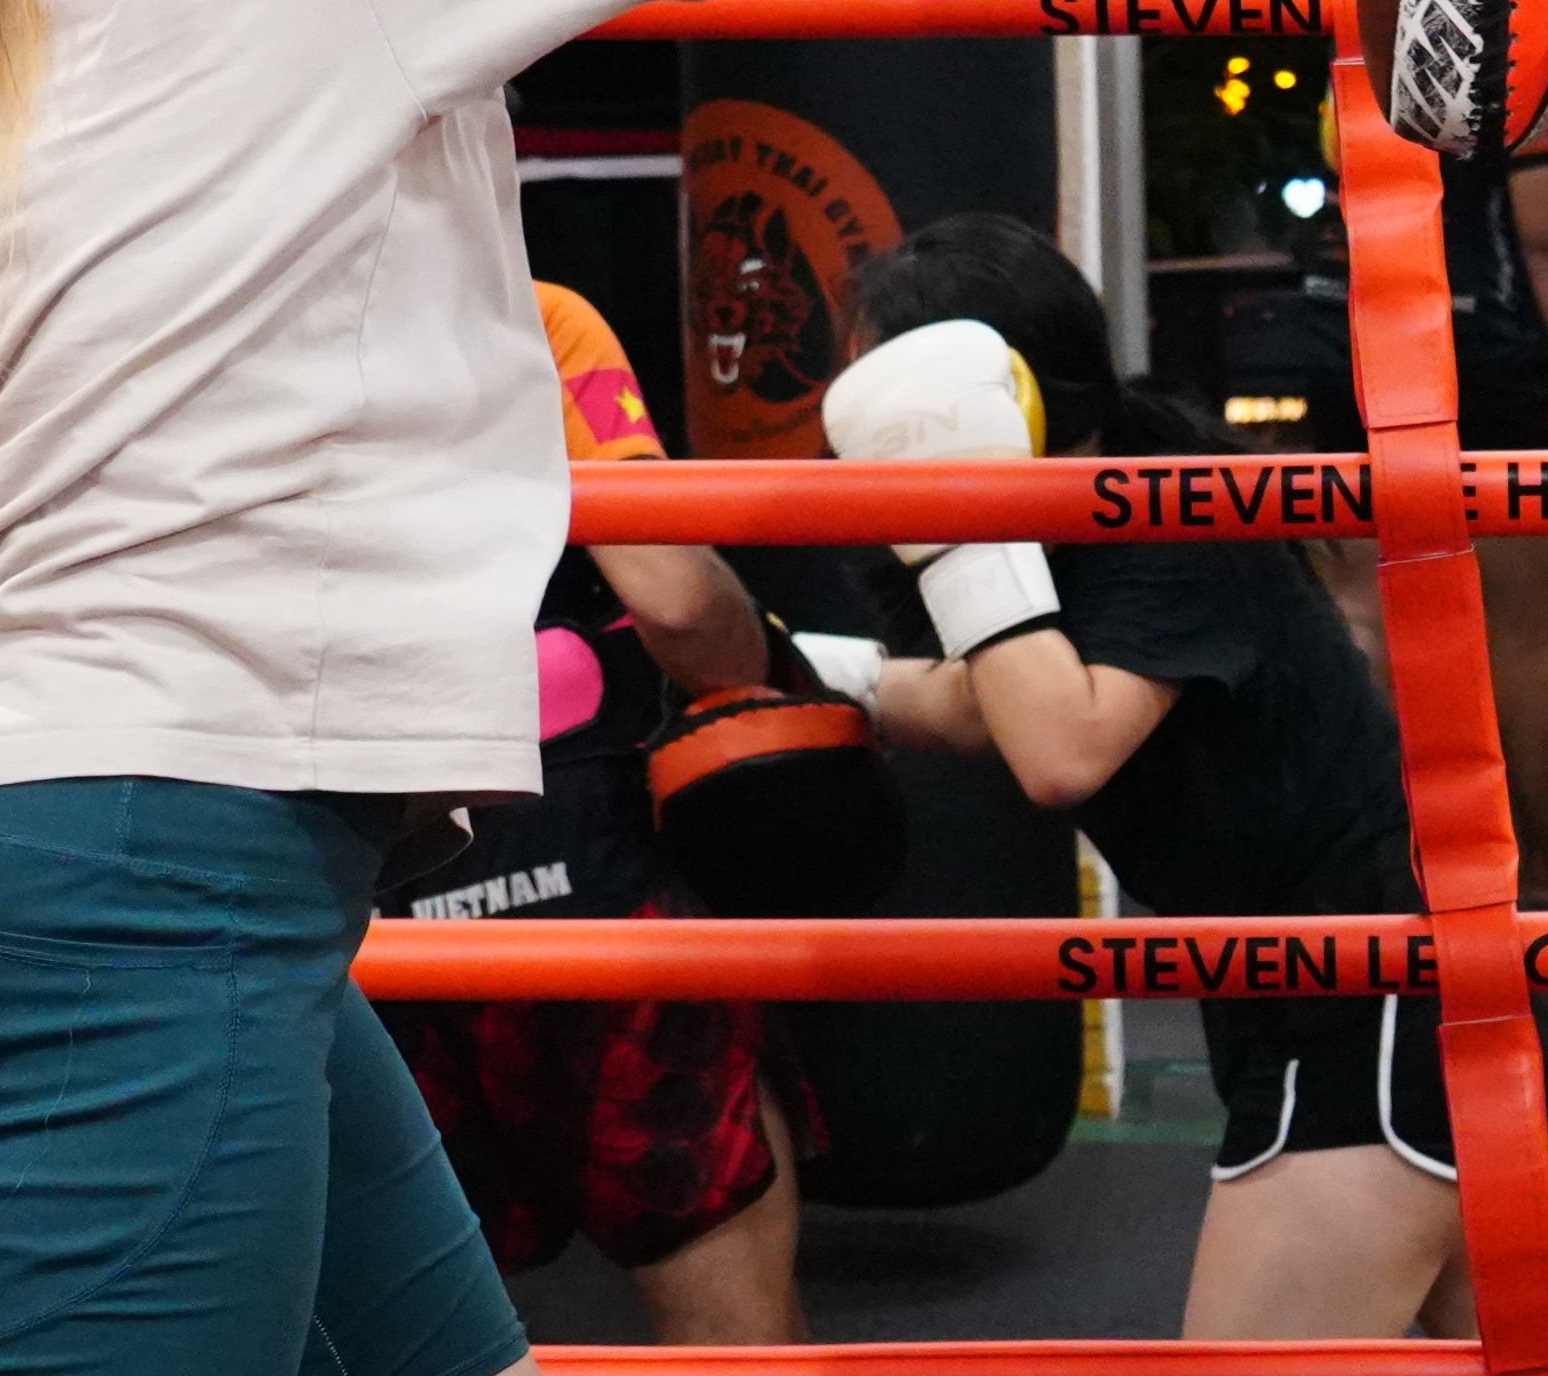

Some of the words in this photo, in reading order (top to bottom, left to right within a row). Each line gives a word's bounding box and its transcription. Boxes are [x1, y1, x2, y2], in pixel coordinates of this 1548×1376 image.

[1091, 466, 1376, 530] STEVEN
[410, 860, 574, 919] VIETNAM
[1056, 933, 1336, 995] STEVEN
[1367, 934, 1440, 991] LE
